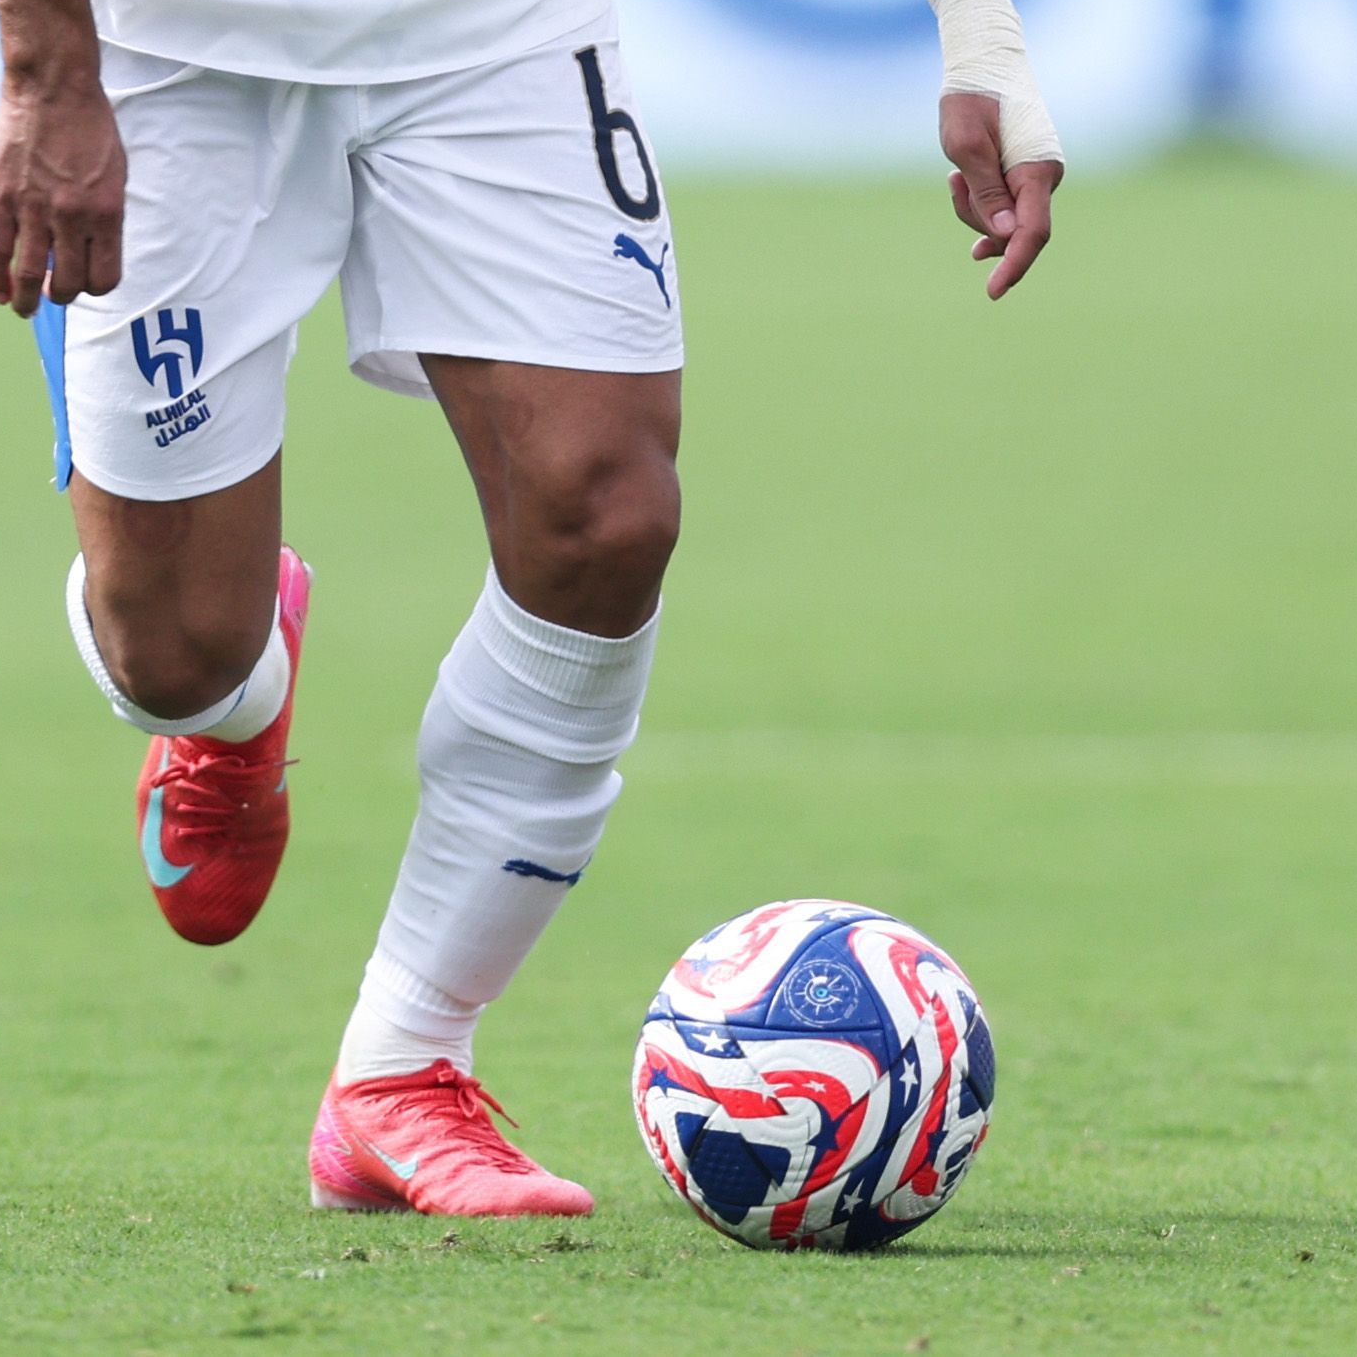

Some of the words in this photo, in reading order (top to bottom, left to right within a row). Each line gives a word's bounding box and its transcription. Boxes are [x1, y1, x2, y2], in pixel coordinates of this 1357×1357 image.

[573, 45, 661, 222] 6
[145, 388, 206, 429] ALHILAL
[154, 403, 212, 448] الهلال
